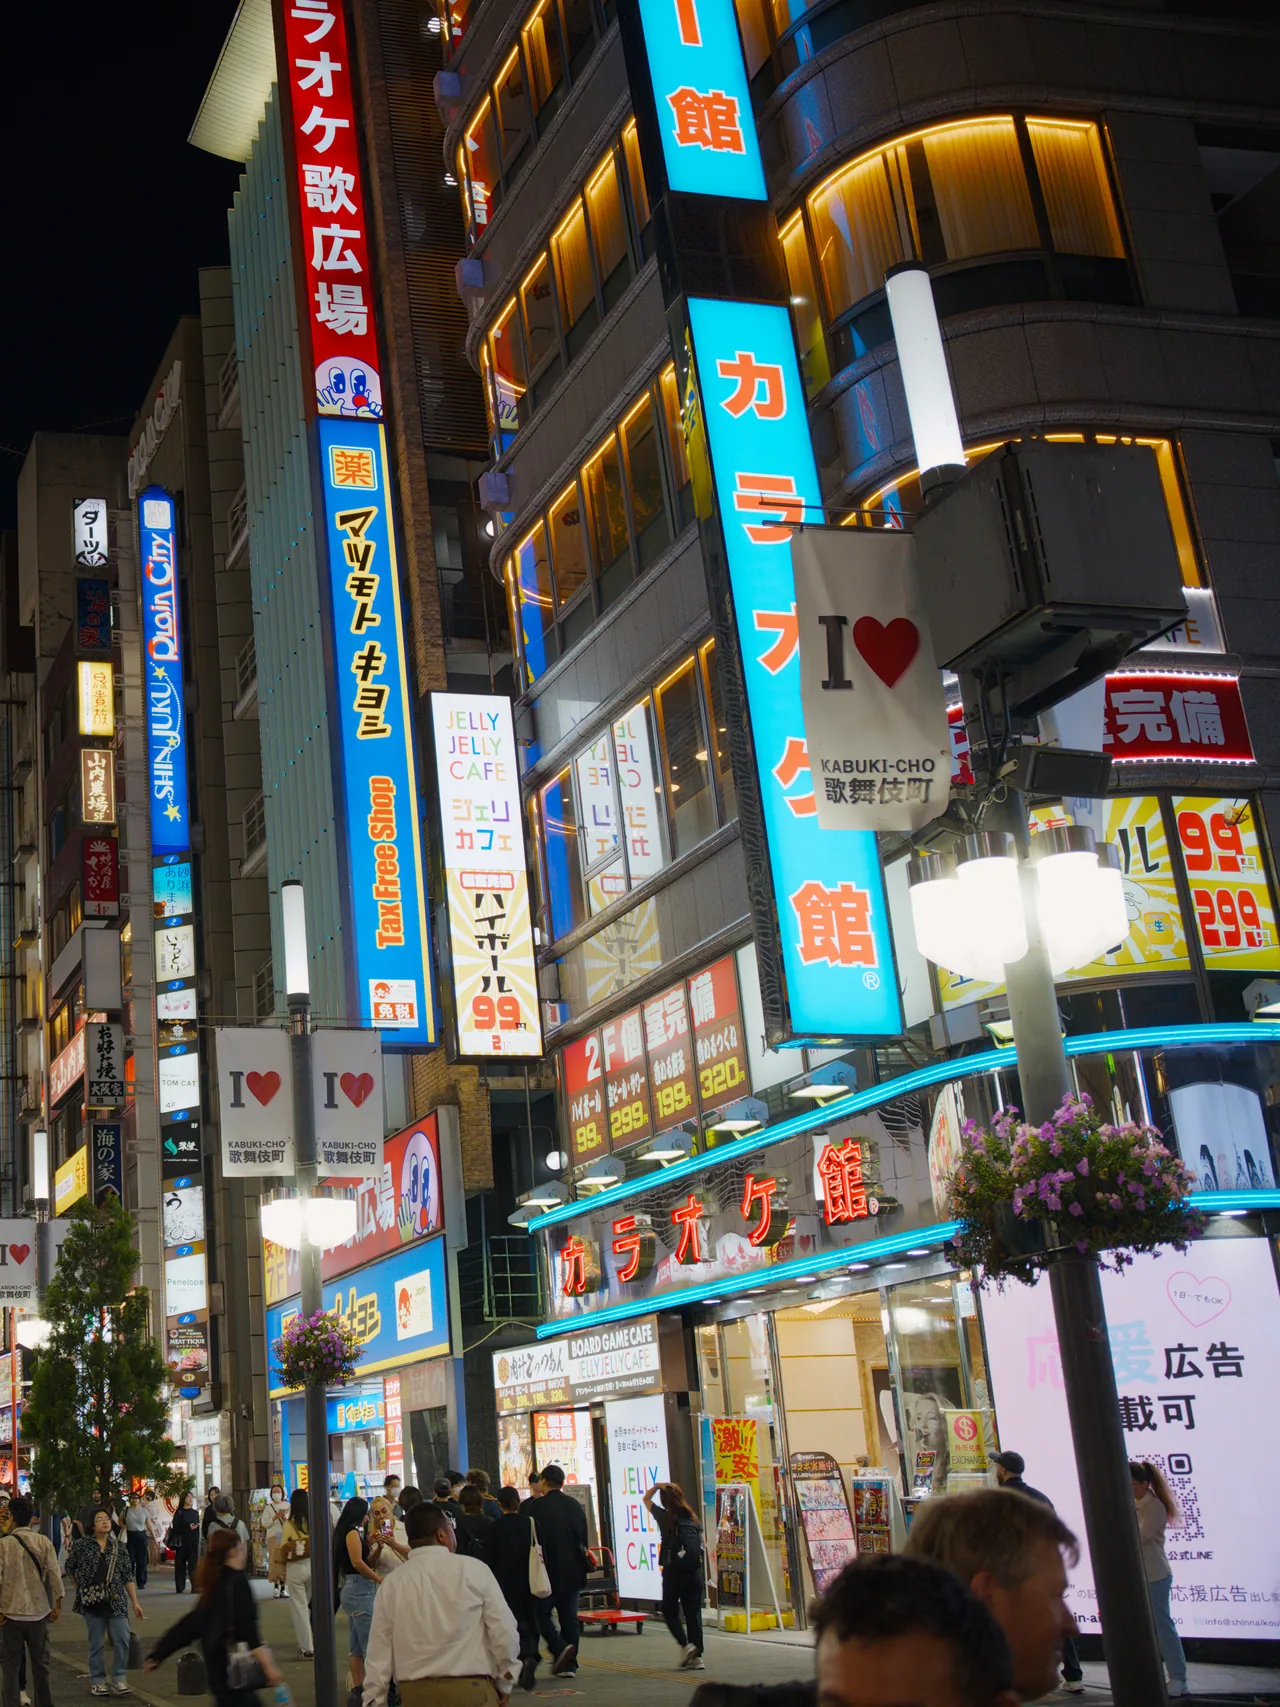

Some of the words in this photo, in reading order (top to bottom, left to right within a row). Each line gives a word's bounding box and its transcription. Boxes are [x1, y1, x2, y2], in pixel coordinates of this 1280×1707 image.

[290, 0, 369, 336] ラオケ歌広場
[334, 450, 372, 486] 薬
[81, 510, 100, 556] ダーツ
[145, 532, 174, 587] City
[335, 506, 391, 739] マツモトキヨシ
[818, 615, 854, 691] I
[446, 710, 499, 732] JELLY
[150, 680, 181, 801] SHINJUKU
[449, 735, 502, 757] JELLY
[86, 751, 110, 813] 山内農場
[449, 760, 507, 782] CAFE
[820, 758, 936, 776] KABUKI-CHO
[368, 775, 398, 841] Shop
[824, 777, 935, 806] 歌舞伎町
[455, 828, 513, 852] カフェ
[177, 866, 191, 892] 砂浜
[372, 843, 400, 902] Free
[93, 902, 111, 915] 4F
[164, 866, 177, 916] あります
[376, 901, 405, 950] Tax
[474, 892, 515, 993] ハイボール
[378, 1002, 412, 1019] 免税
[585, 1026, 617, 1083] 2F
[621, 971, 716, 1064] 個室完備
[95, 1024, 118, 1081] お好み焼
[90, 1082, 124, 1097] 大阪家
[162, 1079, 179, 1087] TOM
[229, 1071, 246, 1109] I
[322, 1071, 339, 1109] I
[699, 1056, 746, 1100] 320円
[571, 1088, 602, 1123] ハイボール
[655, 1079, 693, 1119] 199円
[576, 1121, 603, 1153] 99円
[609, 1100, 650, 1140] 299円
[96, 1129, 116, 1181] 海の家
[228, 1140, 287, 1149] KABUKI-CHO
[228, 1150, 286, 1165] 歌舞伎町
[321, 1140, 378, 1150] KABUKI-CHO
[321, 1150, 377, 1166] 歌舞伎町
[560, 1136, 870, 1297] カラオケ館
[0, 1243, 9, 1267] I
[166, 1277, 205, 1287] Penelope
[266, 1261, 286, 1298] 7F
[167, 1305, 179, 1313] 7F
[571, 1331, 602, 1359] BOARD
[601, 1326, 630, 1351] GAME
[629, 1322, 654, 1346] CAFE
[950, 1454, 987, 1467] EXCHANGE
[625, 1504, 661, 1533] JELL
